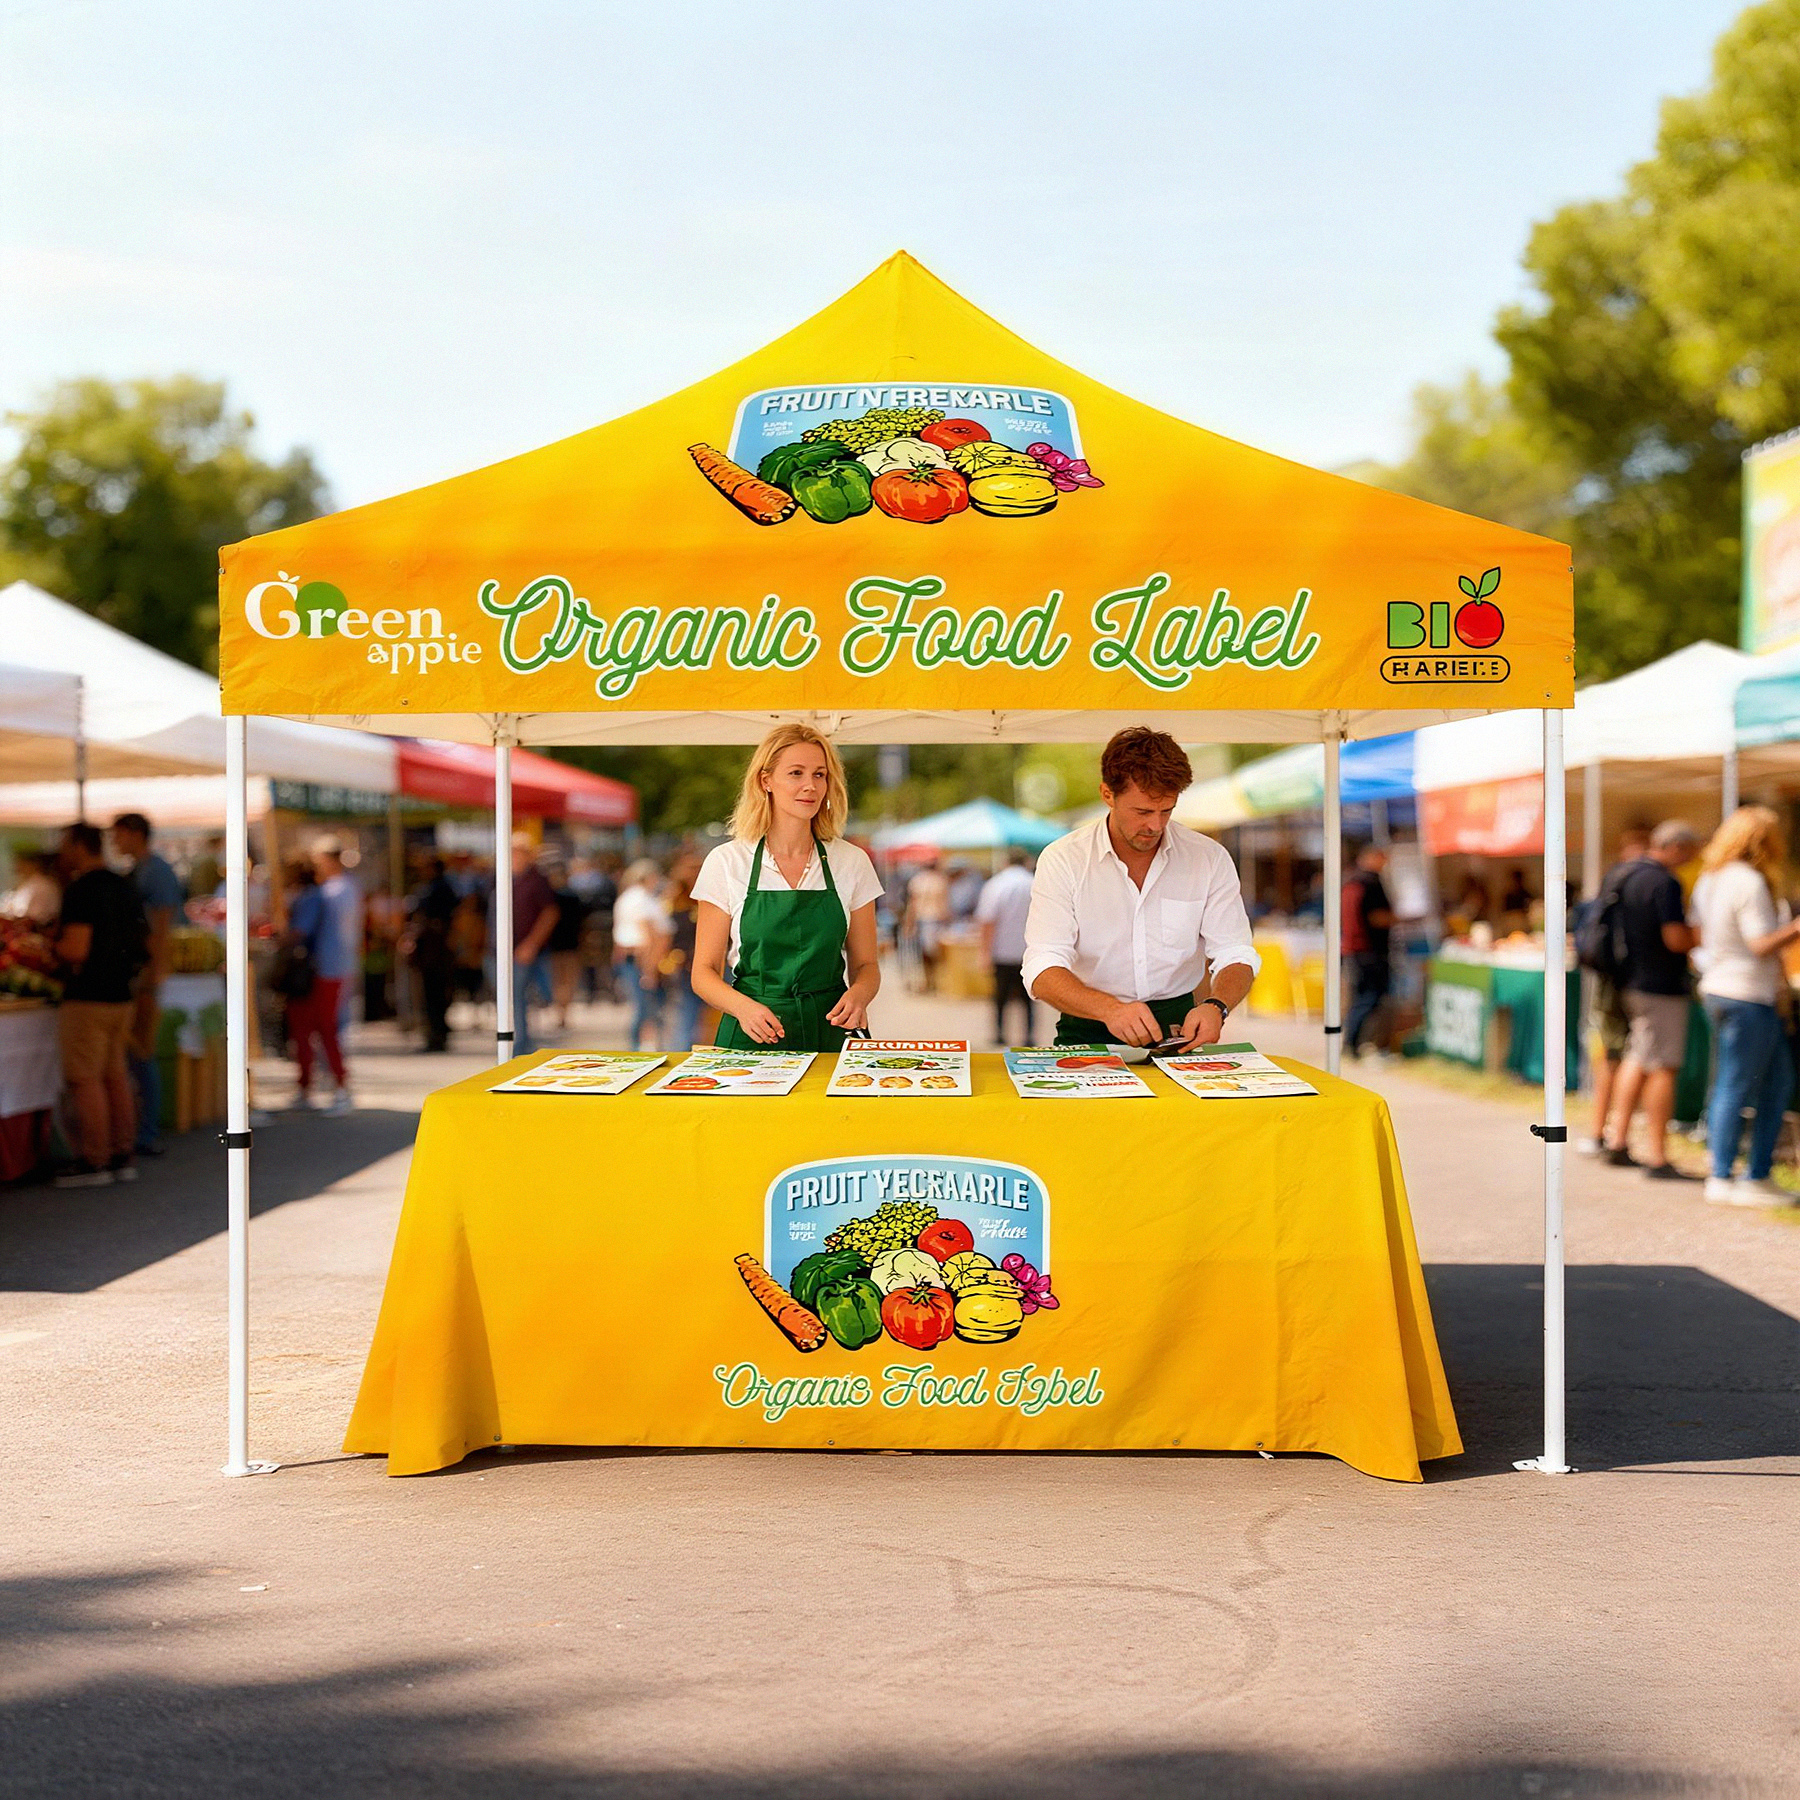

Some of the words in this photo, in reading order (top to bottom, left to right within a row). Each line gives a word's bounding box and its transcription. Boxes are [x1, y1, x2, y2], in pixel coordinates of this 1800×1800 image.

[245, 580, 445, 640] Green
[478, 574, 821, 701] Organic
[839, 575, 1072, 677] Food
[1089, 571, 1321, 692] Label
